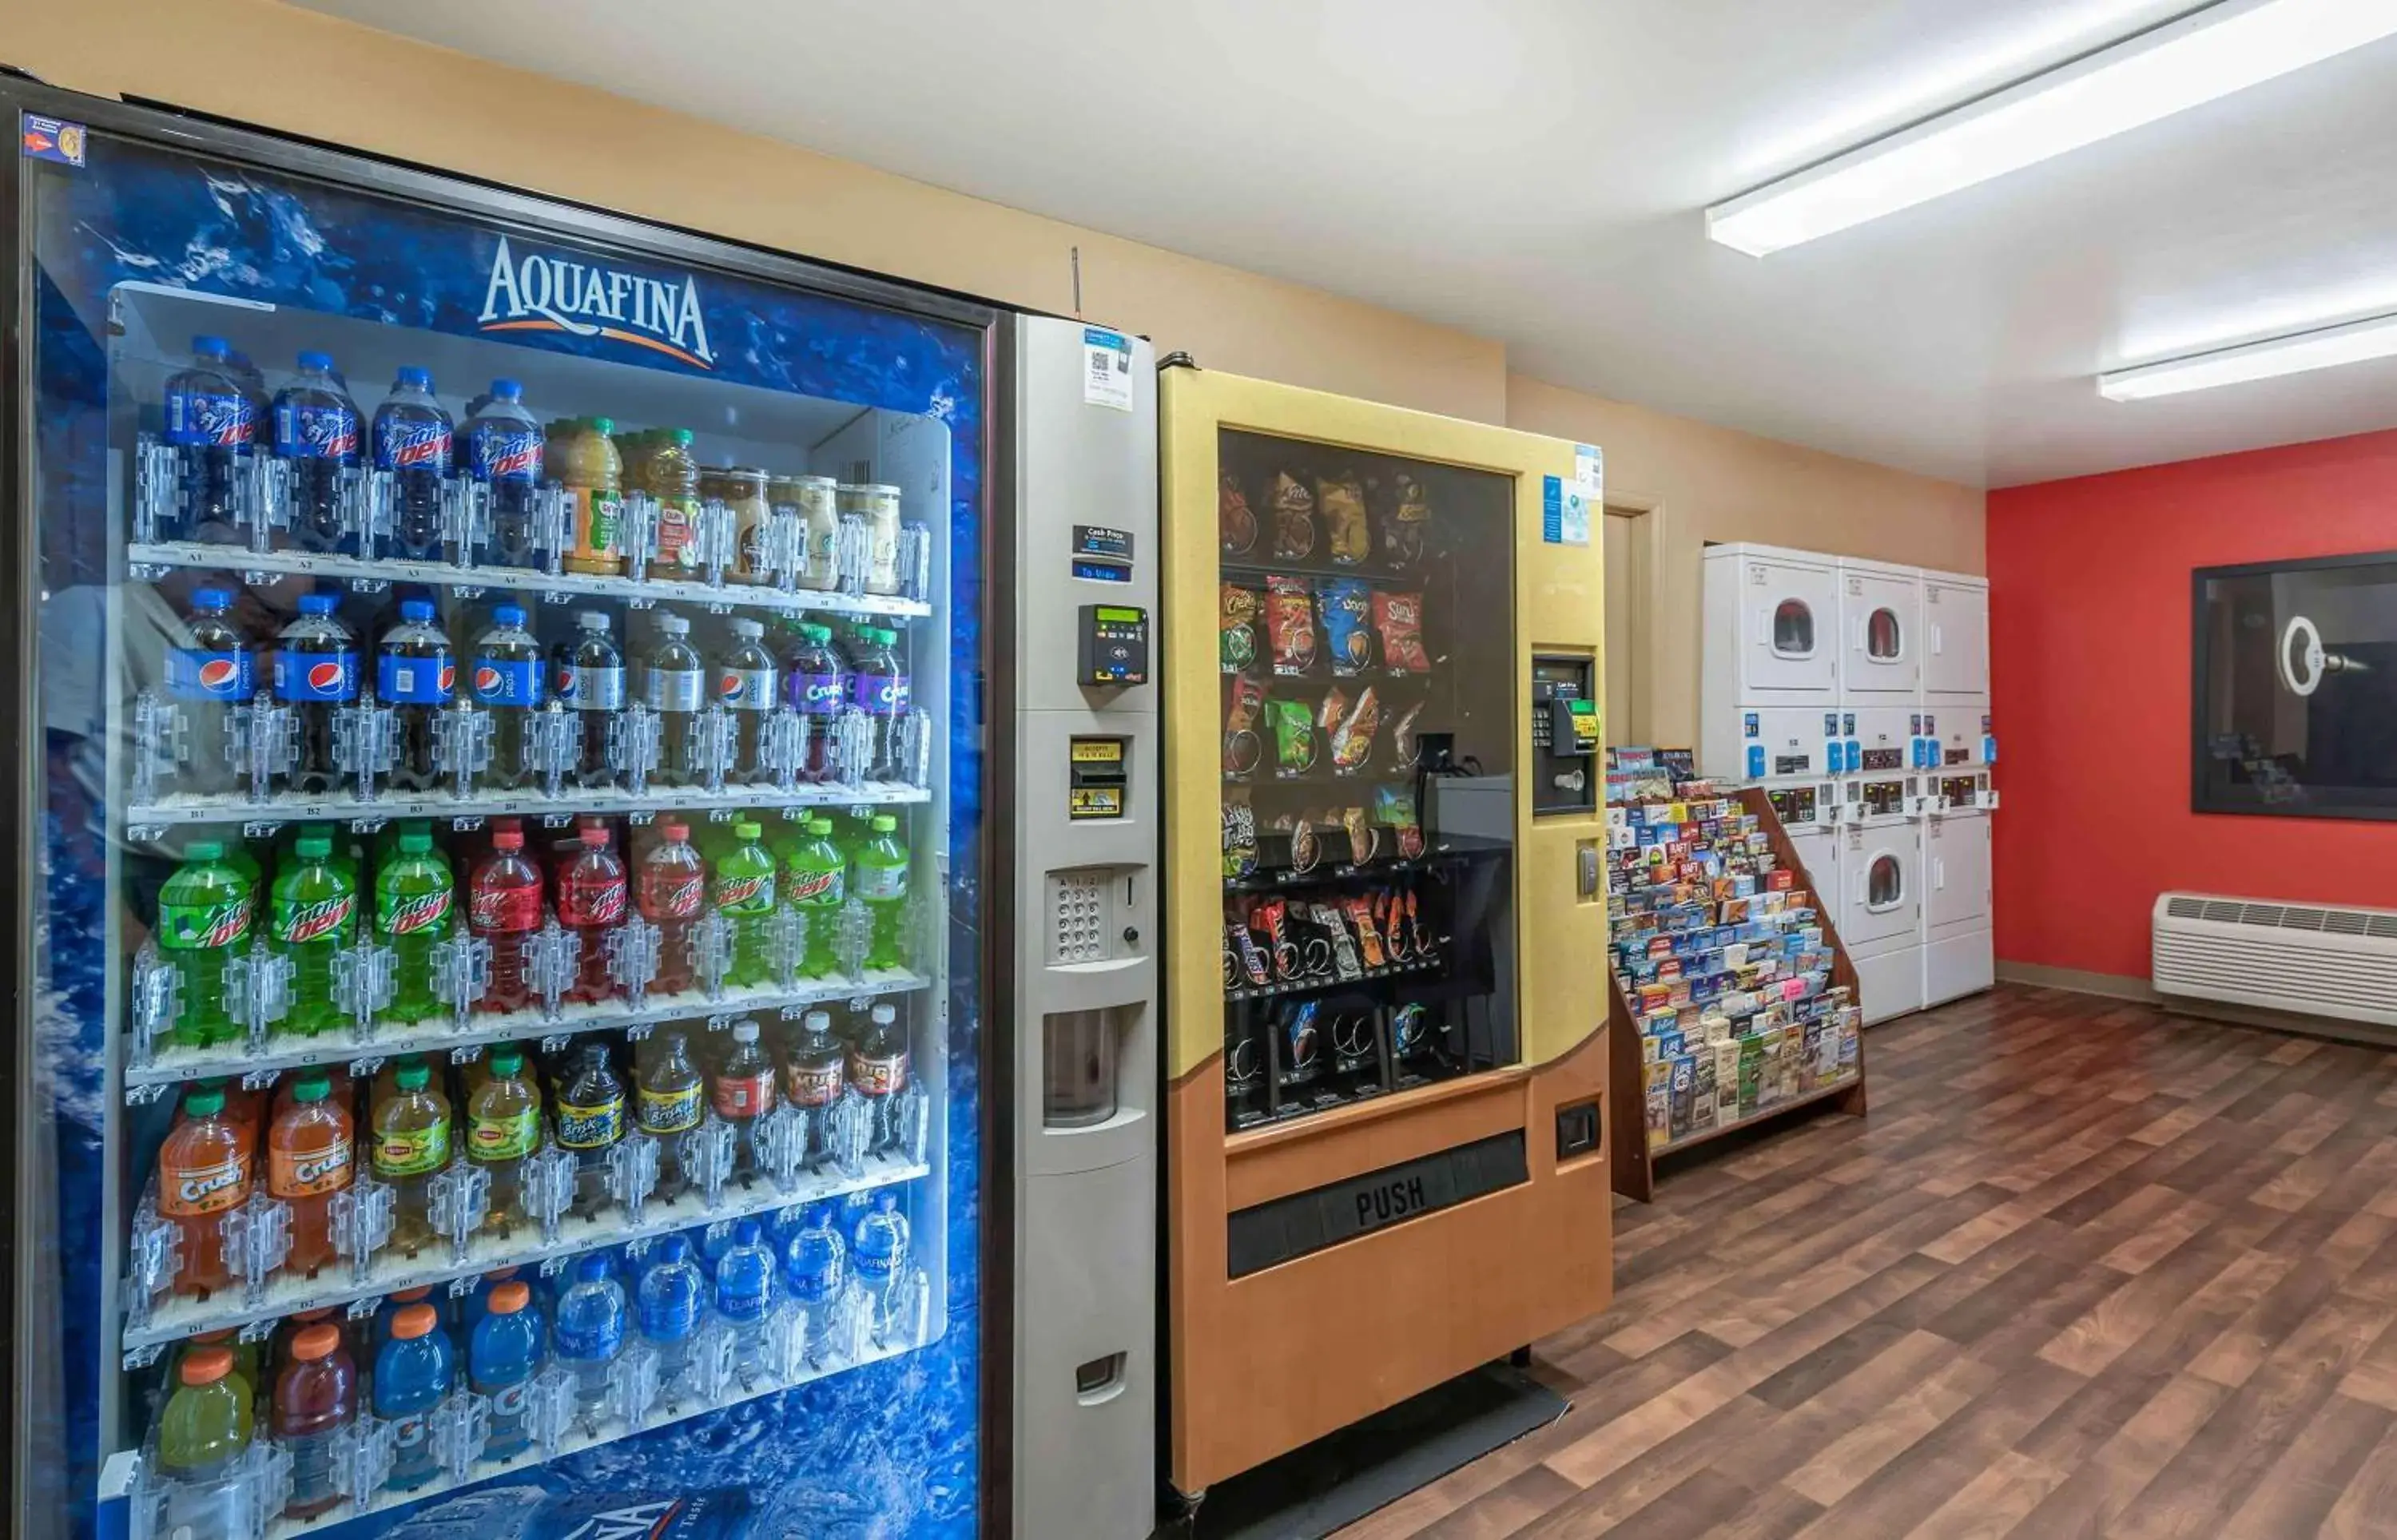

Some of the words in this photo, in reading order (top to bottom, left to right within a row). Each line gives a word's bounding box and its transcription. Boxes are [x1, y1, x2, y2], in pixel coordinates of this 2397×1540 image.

[479, 232, 713, 363] AQUAFINA
[180, 1160, 244, 1202] Crush
[296, 1145, 350, 1184] Crush
[1356, 1176, 1426, 1227] PUSH
